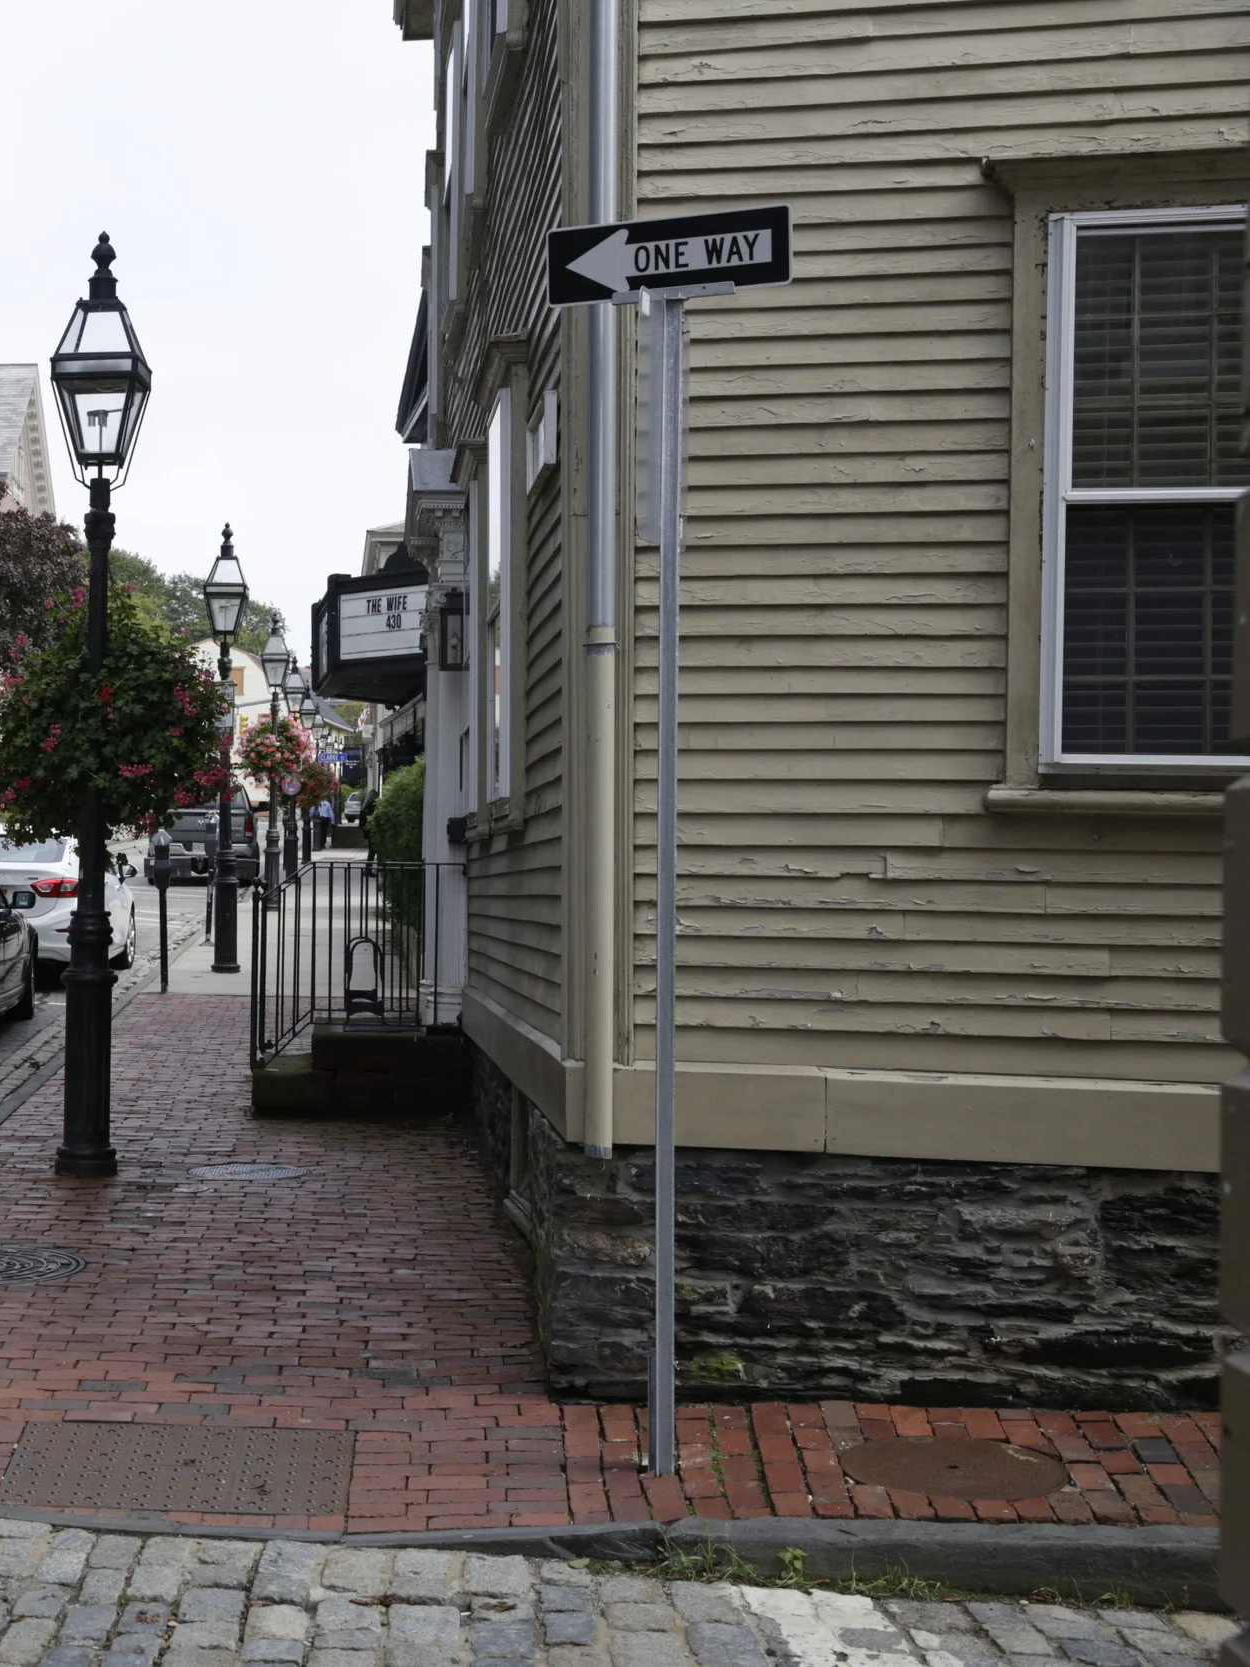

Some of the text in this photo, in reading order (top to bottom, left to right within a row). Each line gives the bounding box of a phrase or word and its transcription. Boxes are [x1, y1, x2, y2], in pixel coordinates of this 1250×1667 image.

[634, 232, 760, 273] ONE WAY
[366, 595, 408, 614] THE WIFE
[386, 613, 402, 629] 430
